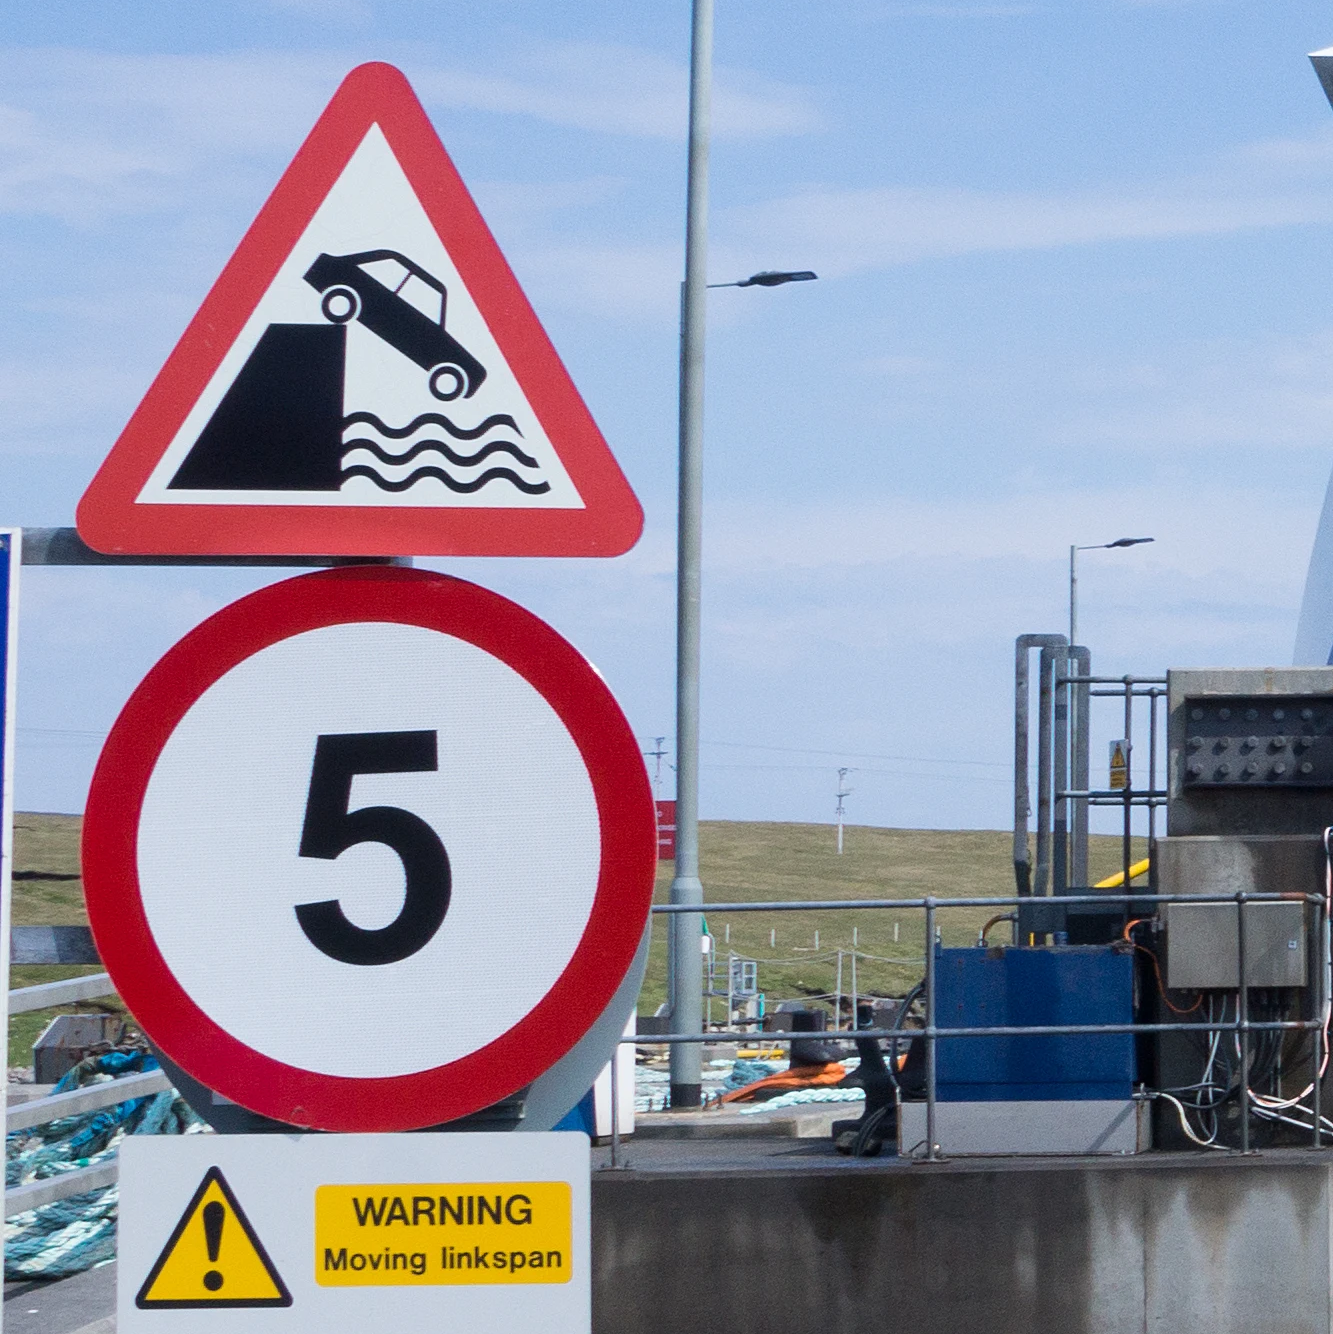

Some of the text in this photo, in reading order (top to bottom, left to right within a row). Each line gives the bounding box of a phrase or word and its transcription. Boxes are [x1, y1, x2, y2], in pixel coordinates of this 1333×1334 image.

[295, 730, 452, 965] 5
[352, 1194, 532, 1226] WARNING
[324, 1245, 562, 1275] Moving linkspan
